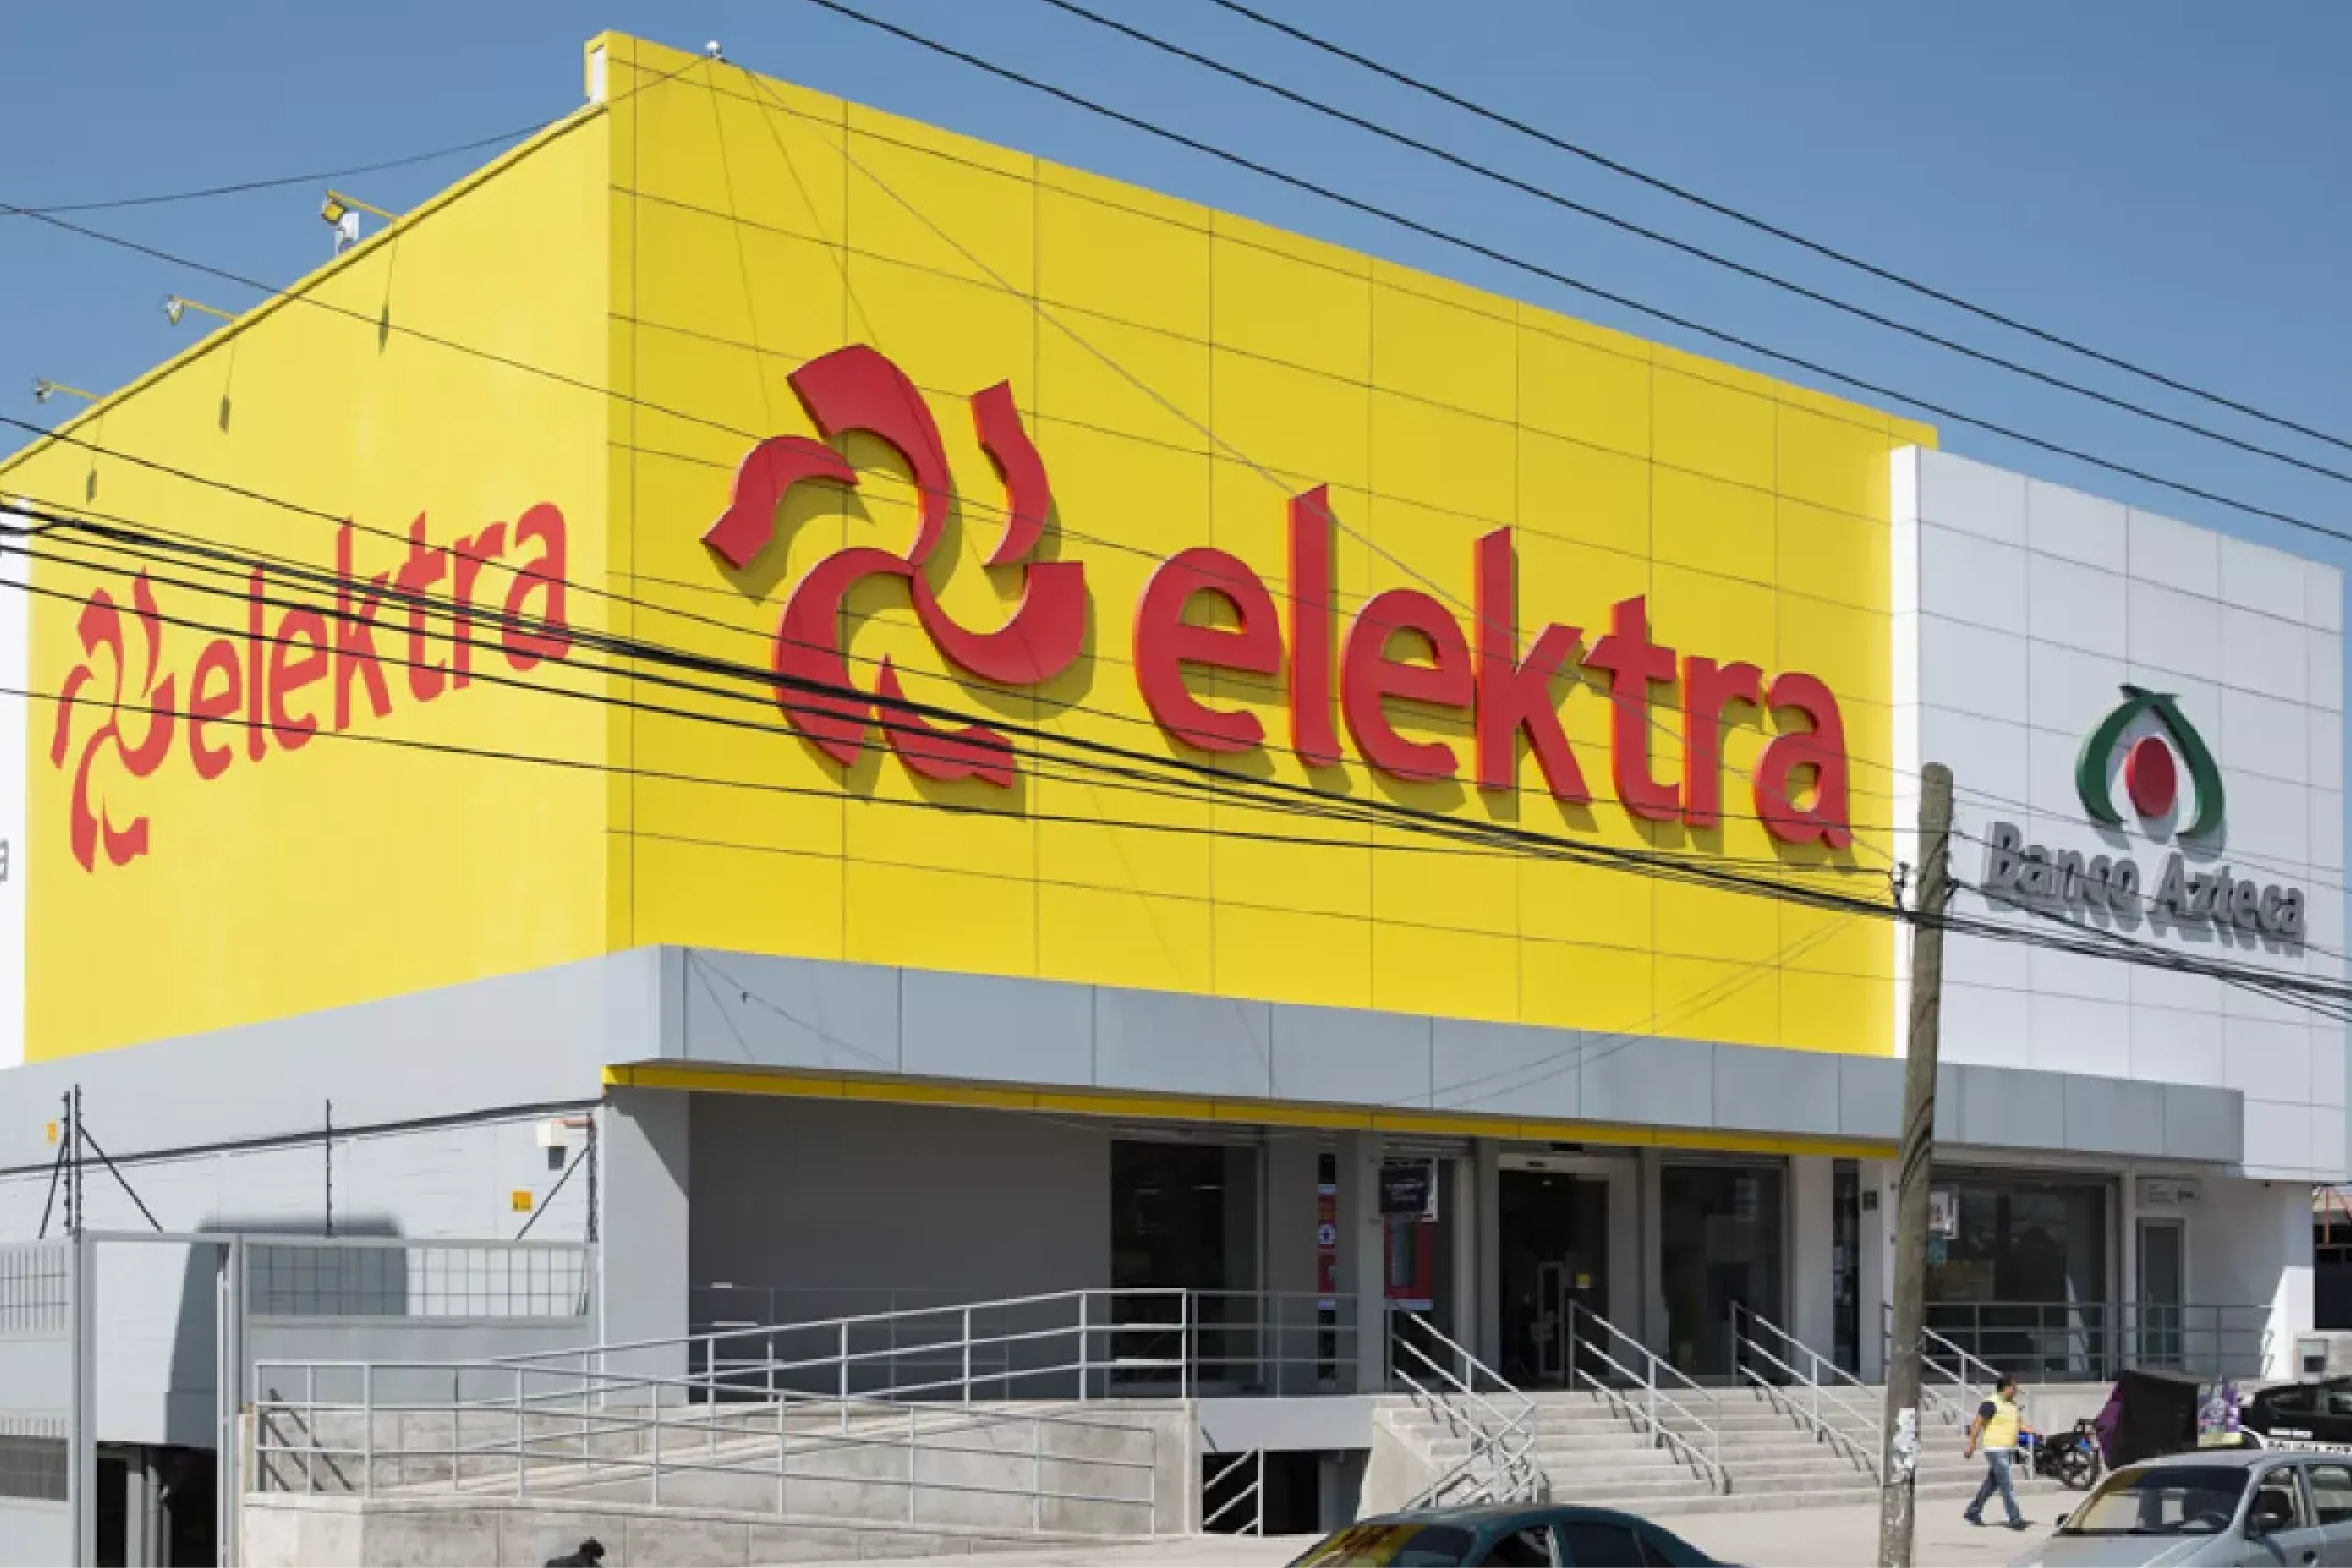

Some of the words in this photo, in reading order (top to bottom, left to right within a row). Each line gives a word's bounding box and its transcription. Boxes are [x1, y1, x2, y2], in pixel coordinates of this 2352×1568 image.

[188, 500, 573, 780] elektra
[1133, 482, 1851, 850] elektra
[1981, 820, 2141, 911] Banco
[2147, 850, 2306, 941] Azteca
